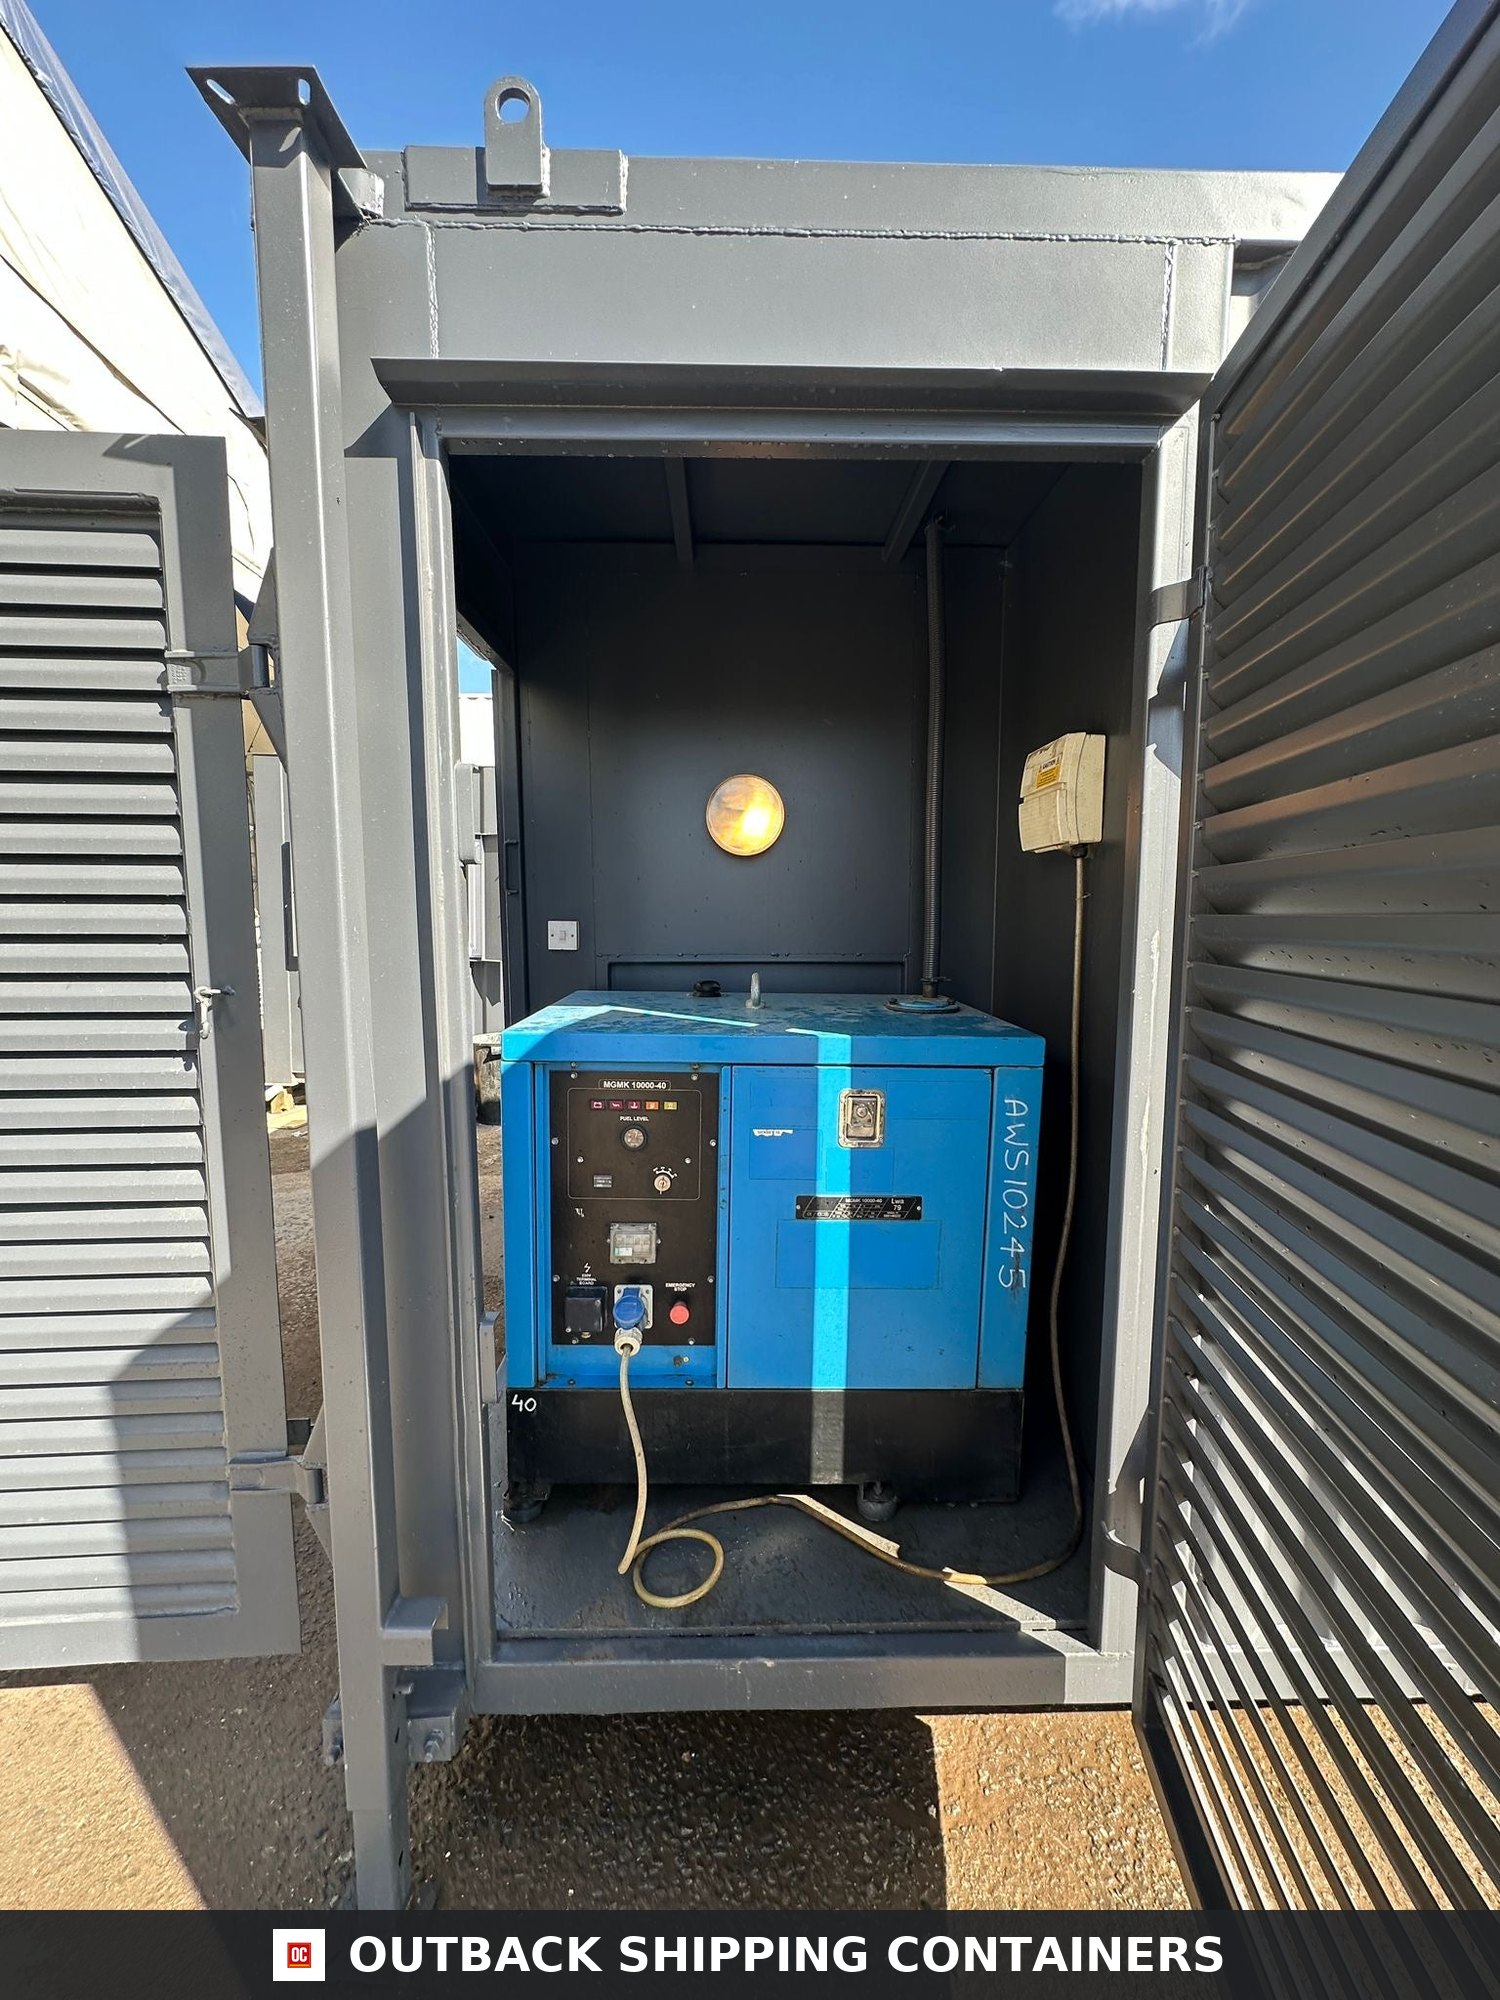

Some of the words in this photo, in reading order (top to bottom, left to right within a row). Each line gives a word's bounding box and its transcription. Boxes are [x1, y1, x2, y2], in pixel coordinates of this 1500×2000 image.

[603, 1081, 630, 1089] MGMK
[631, 1081, 667, 1089] 10000-40
[511, 1394, 537, 1412] 40
